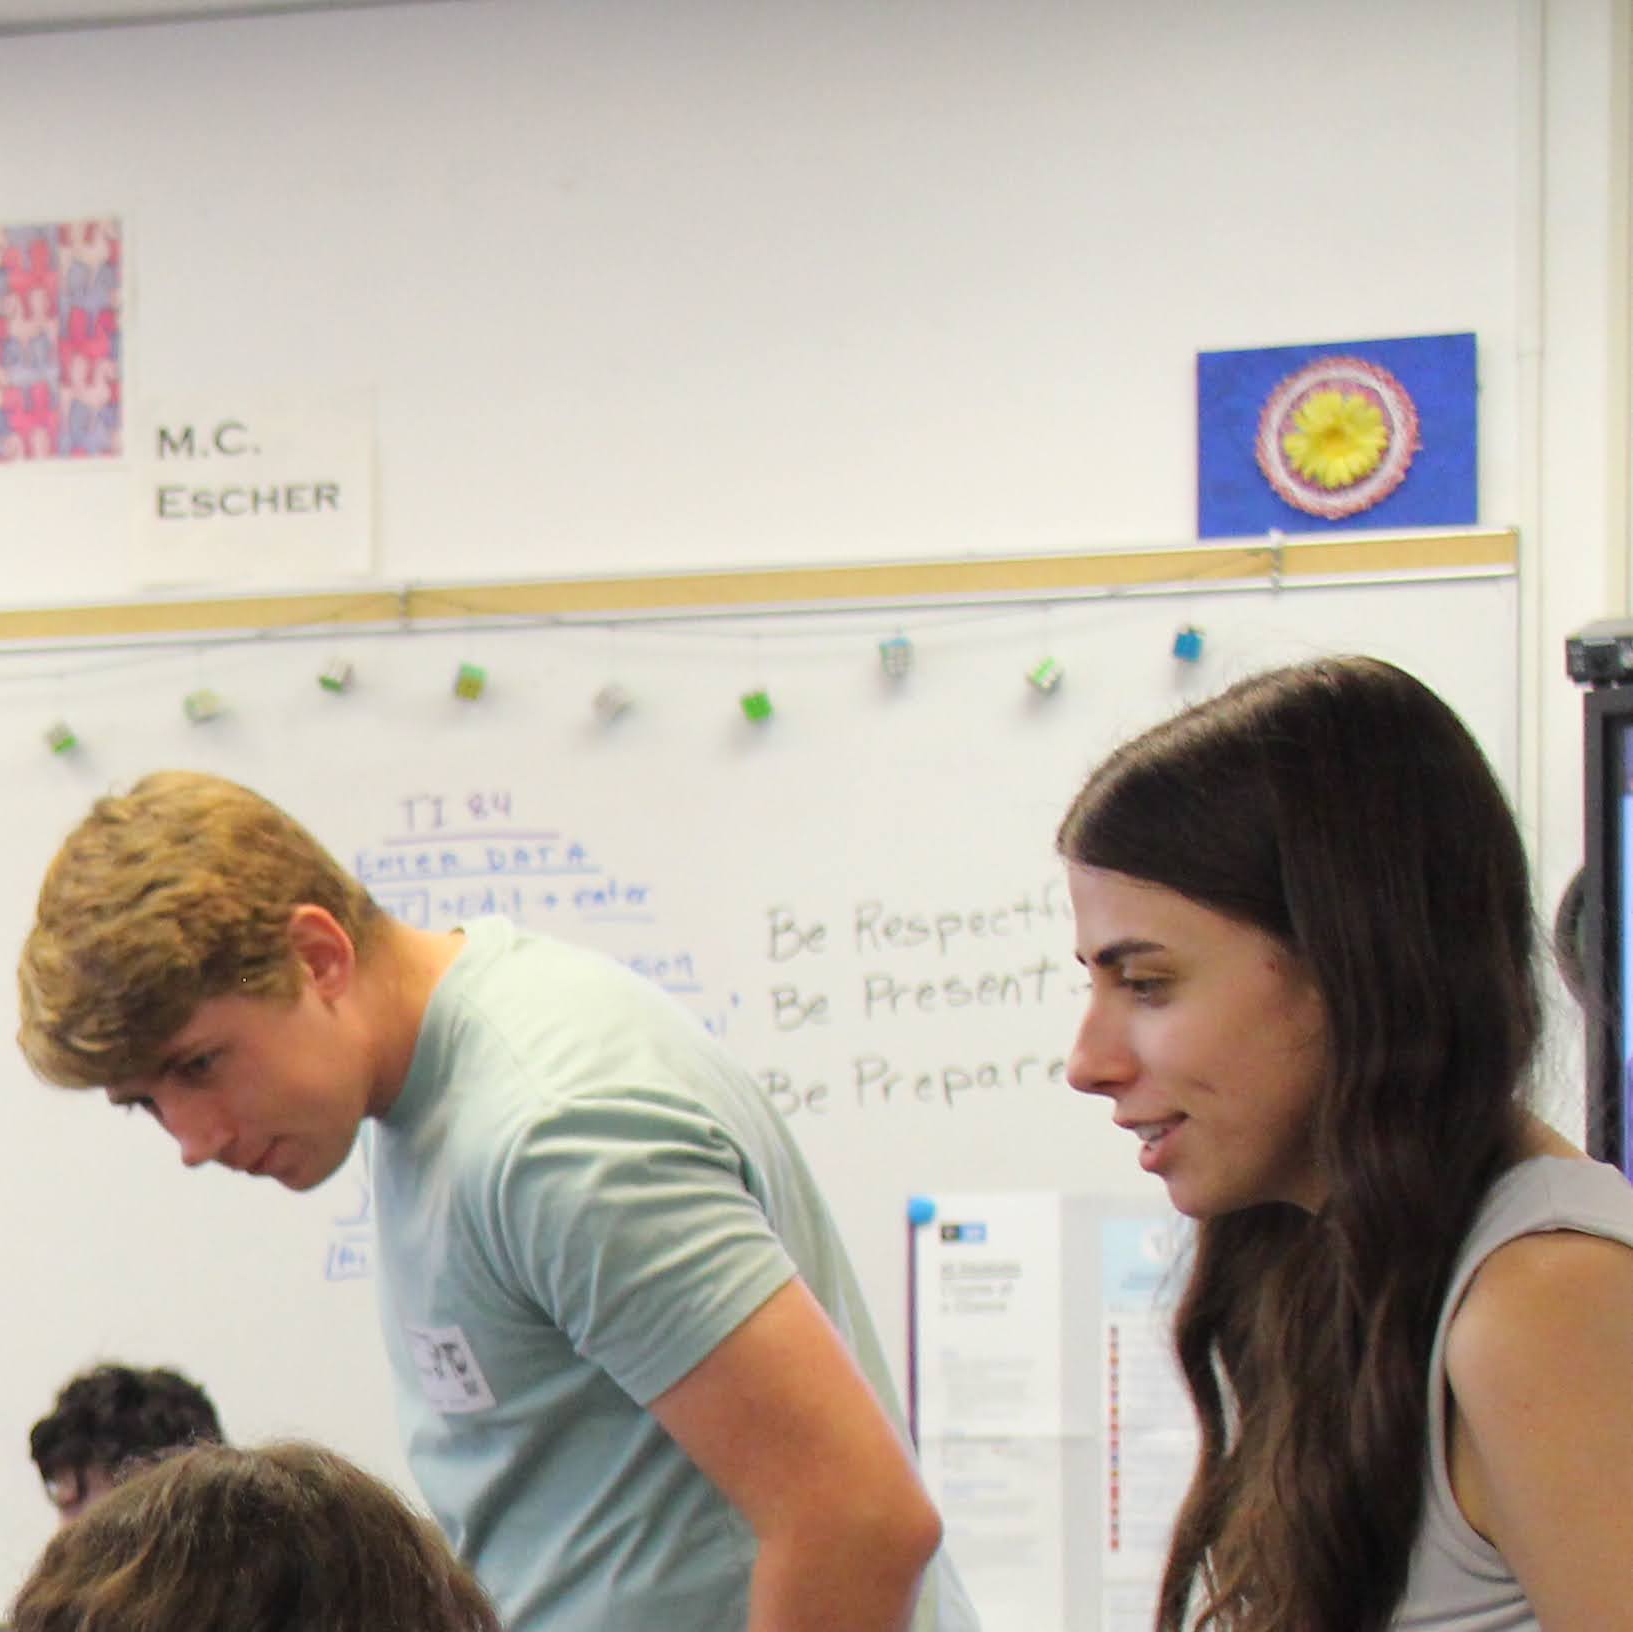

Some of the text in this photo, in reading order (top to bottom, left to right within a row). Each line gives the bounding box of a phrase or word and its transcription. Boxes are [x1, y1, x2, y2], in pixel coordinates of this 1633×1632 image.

[156, 418, 262, 458] M.C.
[466, 792, 513, 819] 84
[484, 843, 588, 873] DATA
[766, 904, 827, 963] Be
[769, 986, 832, 1031] Be
[862, 956, 1060, 1020] Present
[759, 1067, 829, 1117] Be
